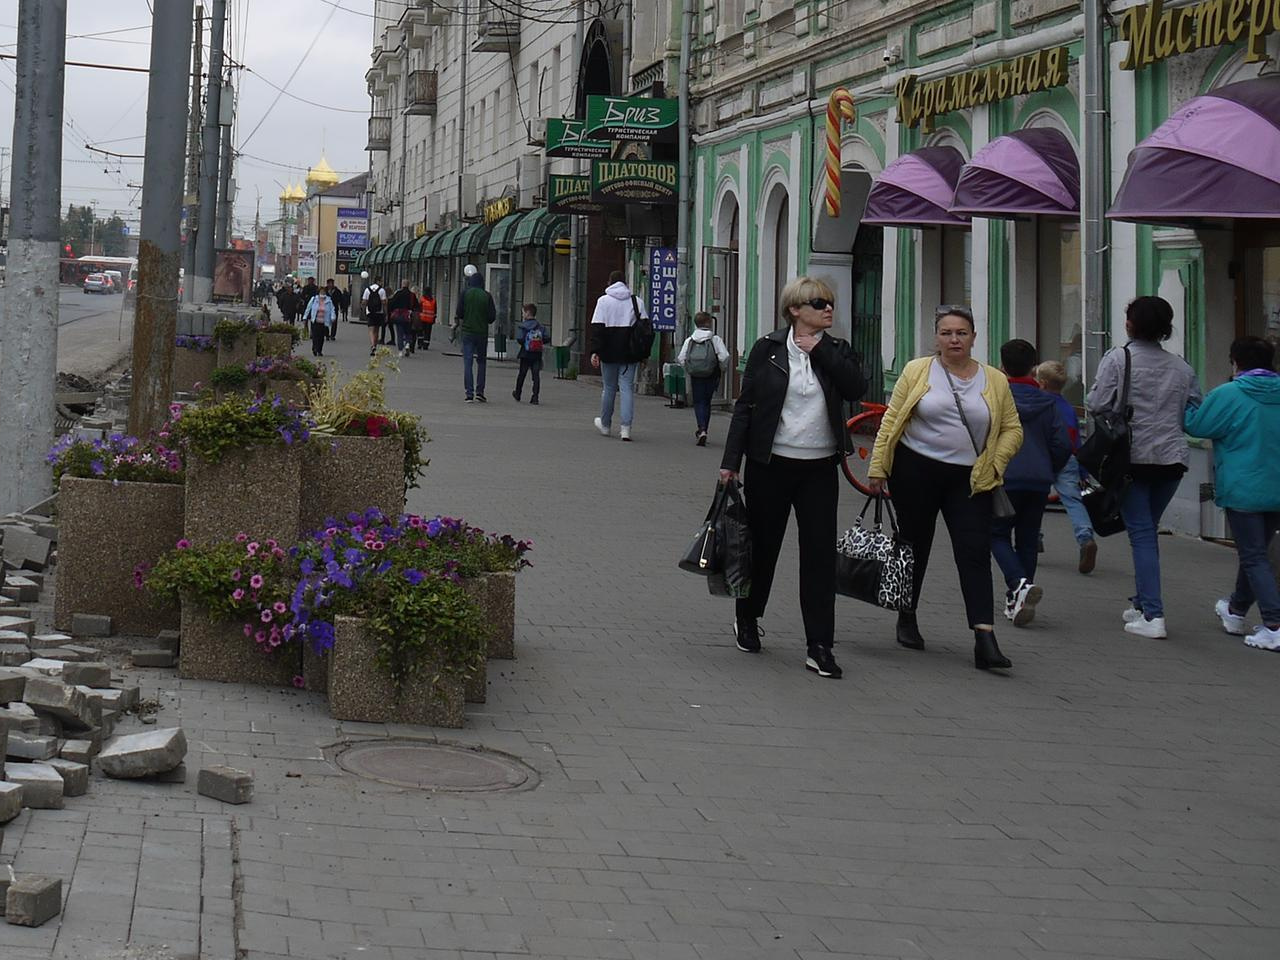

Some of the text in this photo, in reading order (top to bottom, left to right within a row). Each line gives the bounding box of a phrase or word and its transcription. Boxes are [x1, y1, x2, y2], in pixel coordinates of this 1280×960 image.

[895, 47, 1068, 133] Карамельная
[600, 97, 661, 128] Бриз
[607, 127, 658, 136] ТУРИСТИЧЕСКАЯ
[615, 133, 651, 141] КОМПАНИЯ
[598, 162, 676, 186] ПЛАТОНОВ
[652, 249, 661, 321] АВТОШКОЛА
[662, 266, 676, 318] ШАНС
